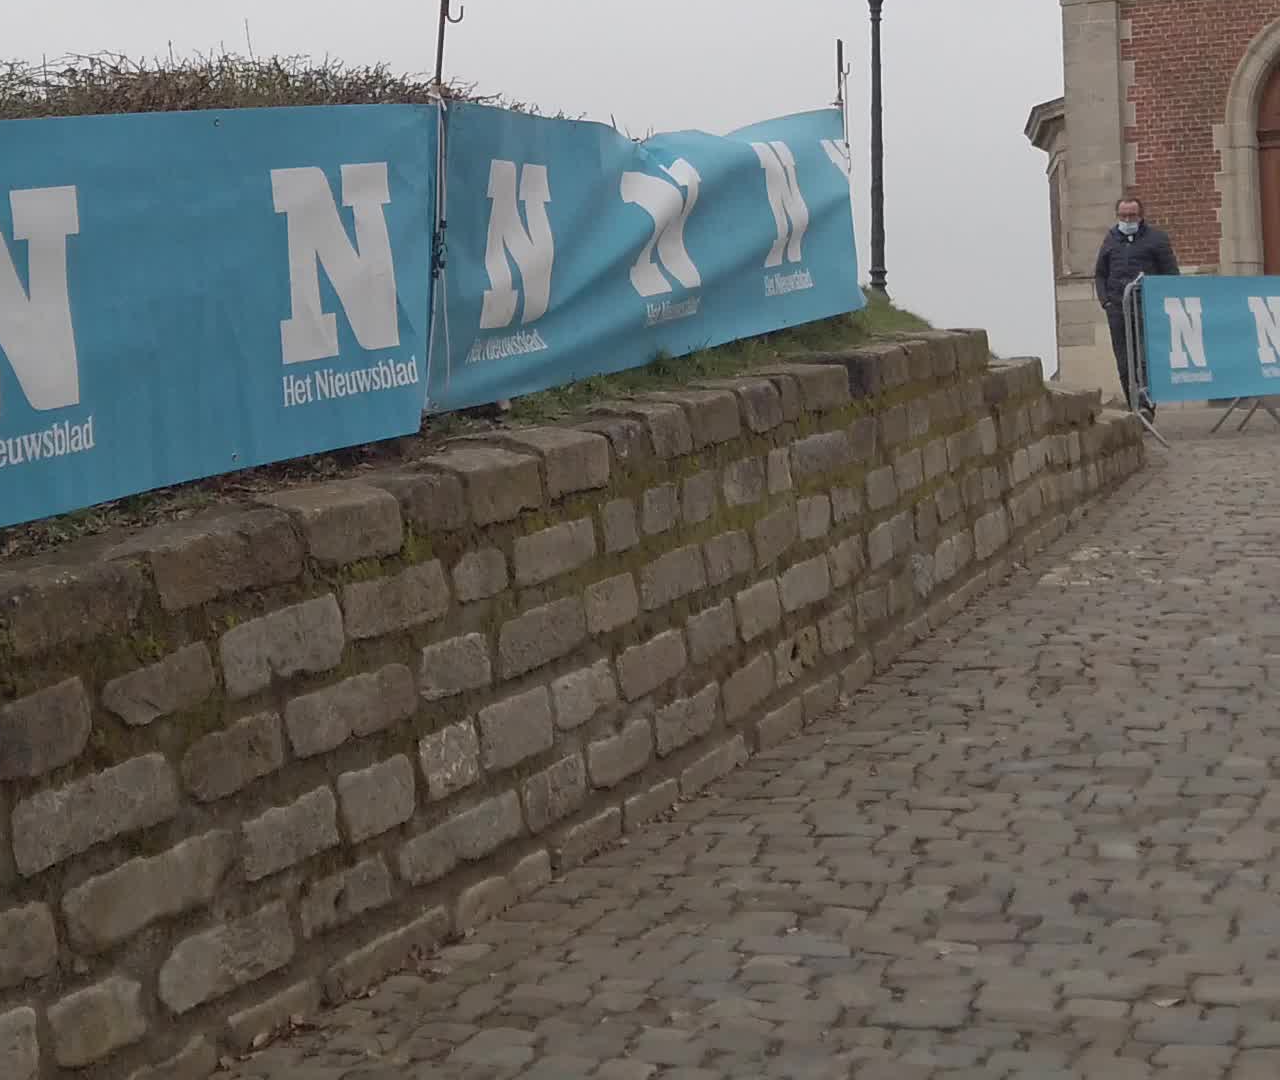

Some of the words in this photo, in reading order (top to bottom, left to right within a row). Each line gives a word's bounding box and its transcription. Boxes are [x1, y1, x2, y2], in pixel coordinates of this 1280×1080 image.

[271, 162, 400, 364] N
[480, 159, 554, 328] N
[750, 141, 809, 267] N
[282, 373, 314, 408] Het
[314, 354, 419, 401] Nieuwsblad
[1164, 297, 1207, 368] N
